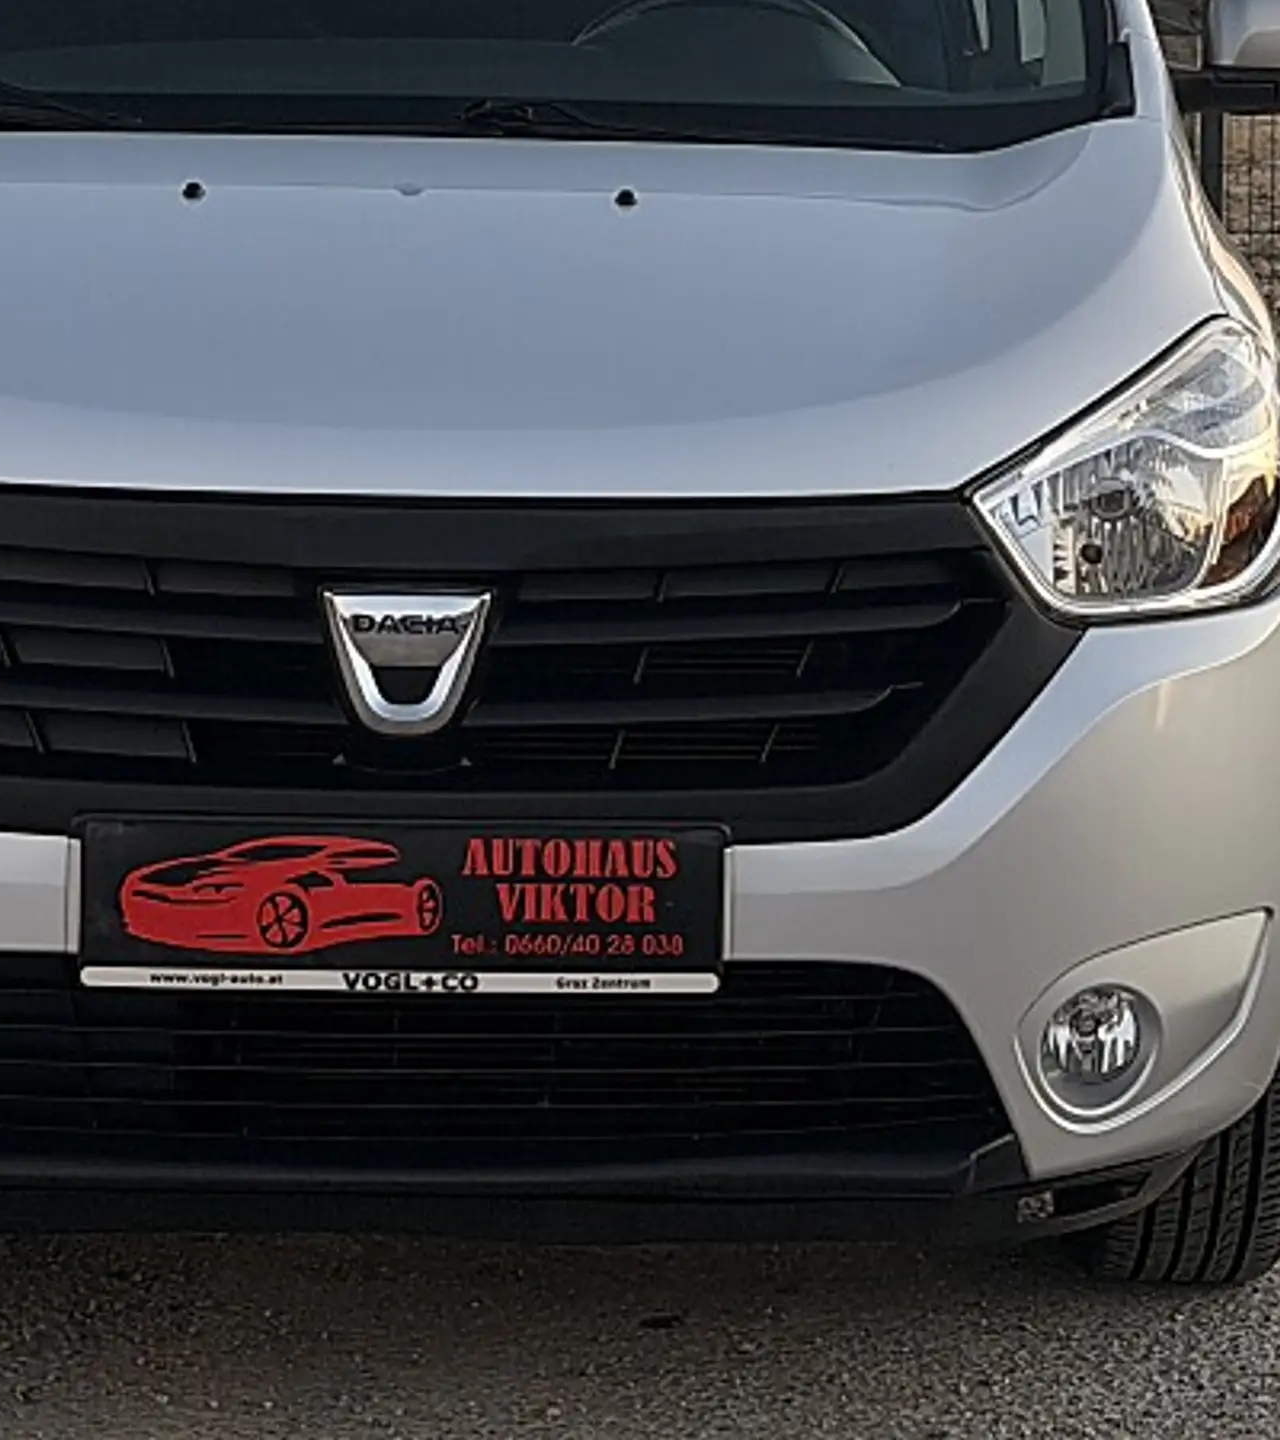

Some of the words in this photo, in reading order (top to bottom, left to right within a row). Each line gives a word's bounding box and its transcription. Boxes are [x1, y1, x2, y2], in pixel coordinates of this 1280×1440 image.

[351, 615, 459, 634] DACIA
[461, 837, 678, 879] AUTOHAUS
[496, 882, 656, 924] VIKTOR
[505, 934, 600, 956] 0660/40
[606, 934, 635, 956] 28
[642, 934, 684, 956] 038
[343, 971, 479, 993] VOGL+CO
